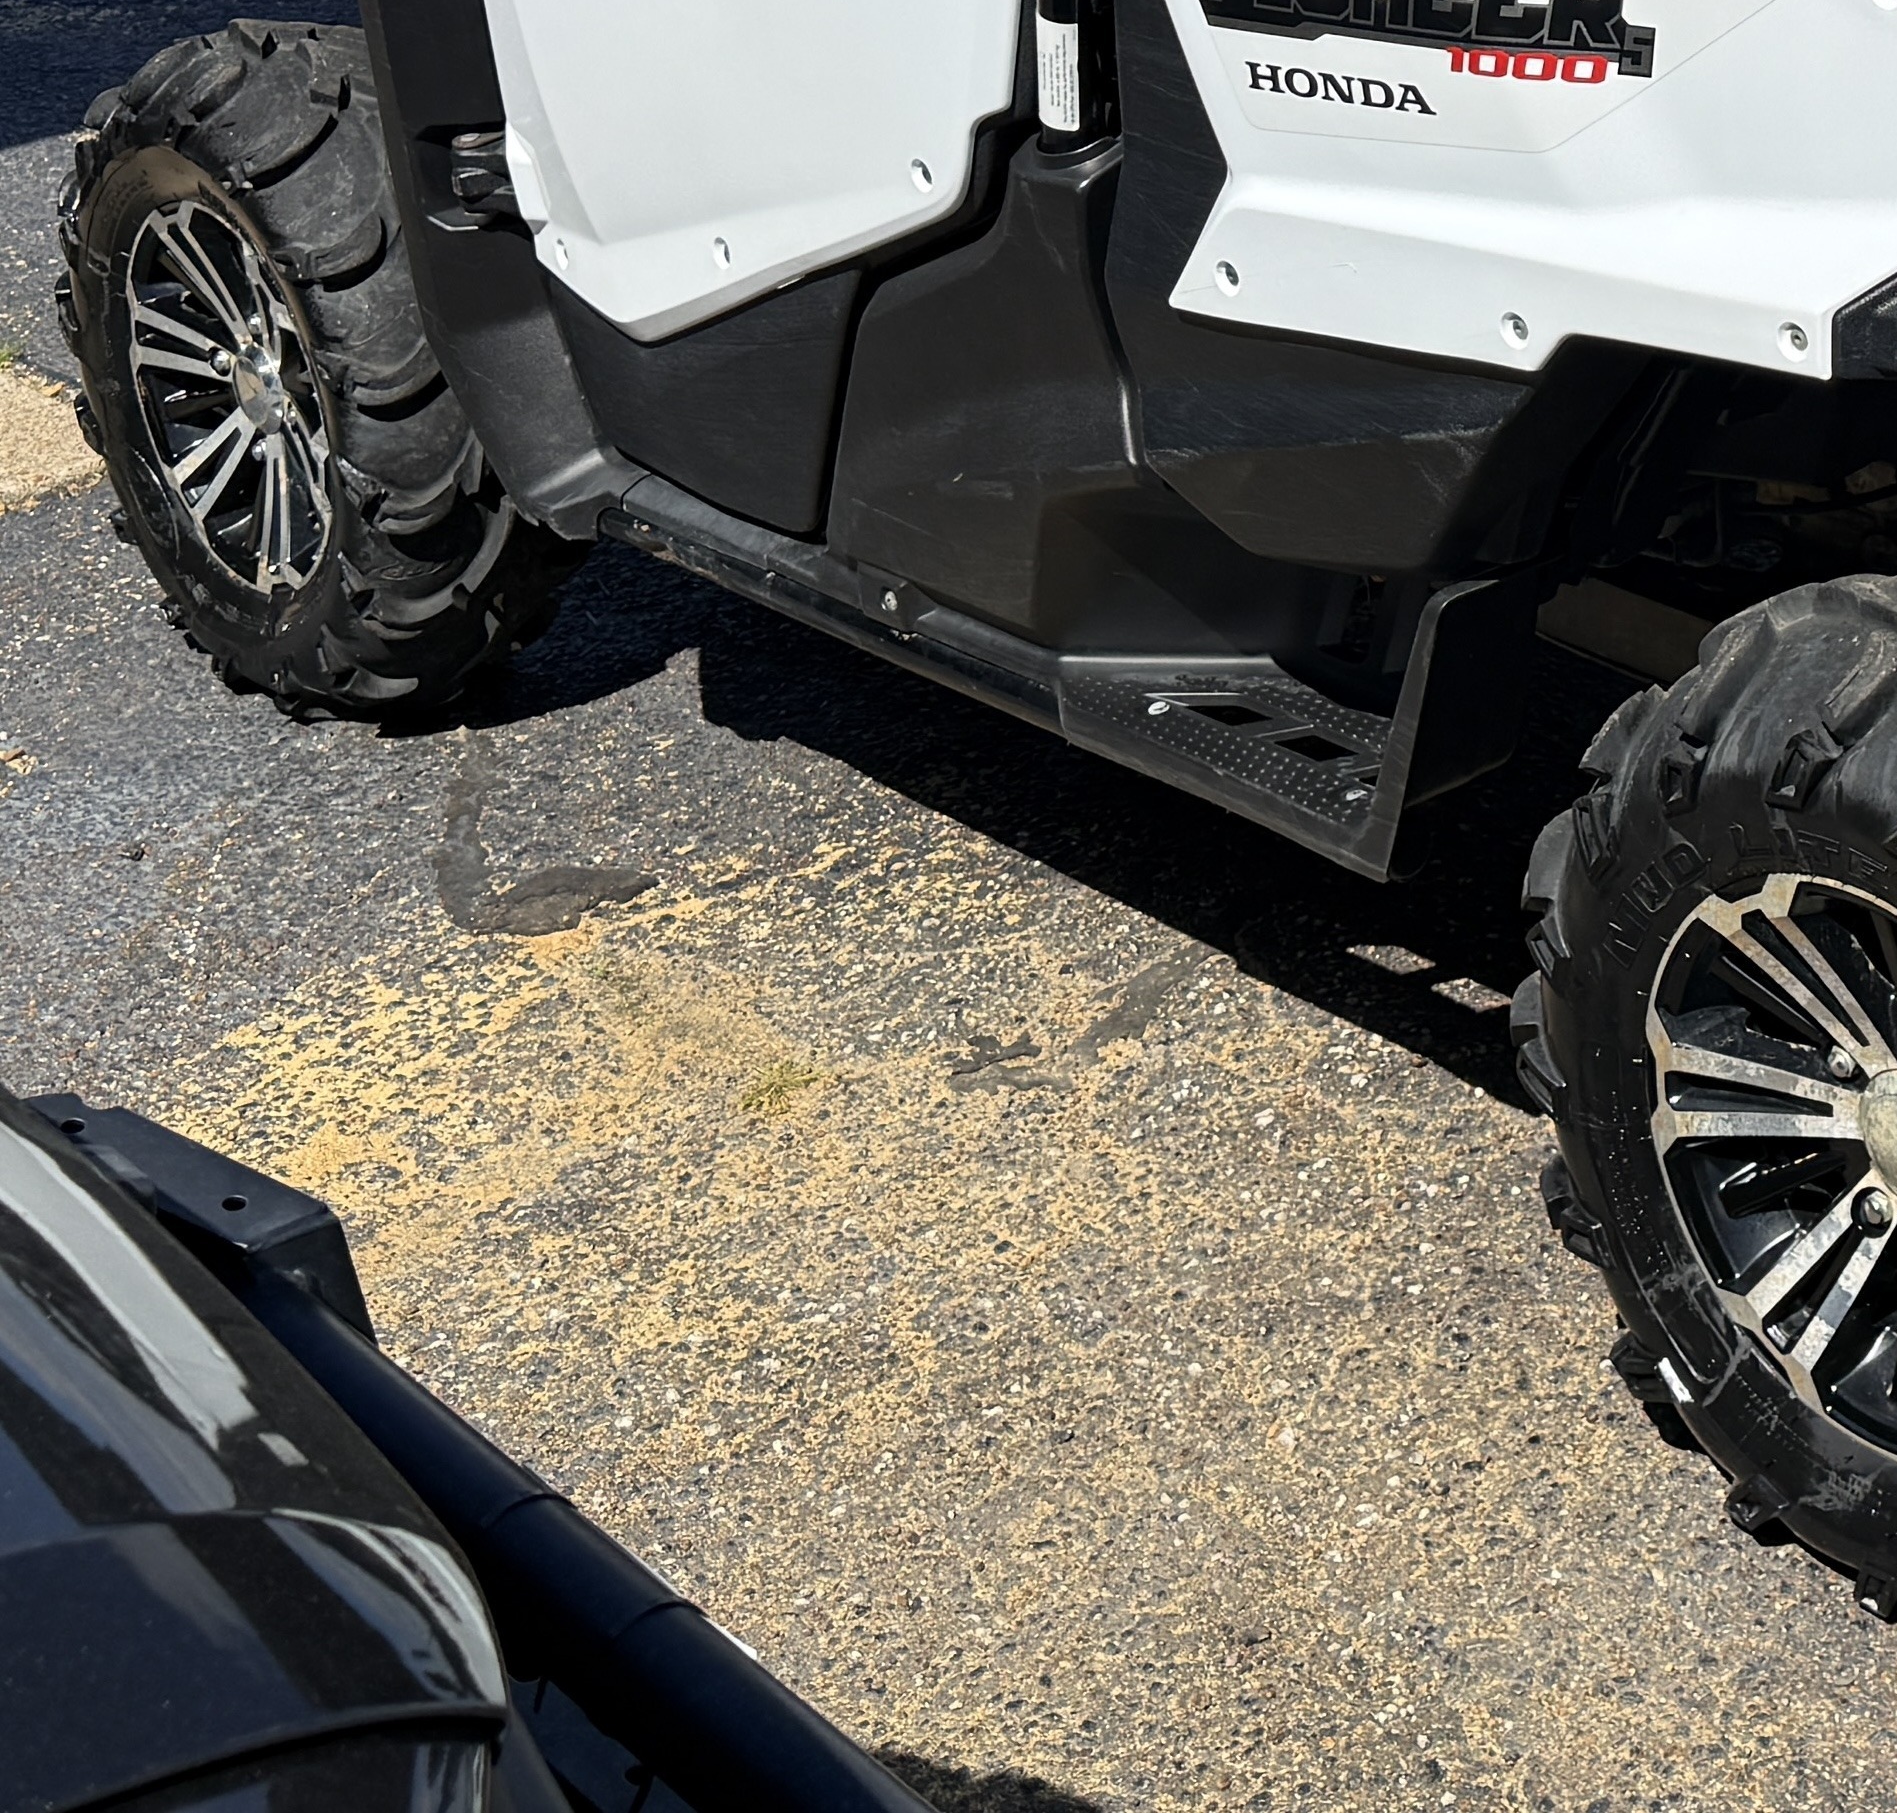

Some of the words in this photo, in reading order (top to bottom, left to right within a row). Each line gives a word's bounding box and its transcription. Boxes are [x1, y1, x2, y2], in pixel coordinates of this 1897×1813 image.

[1245, 61, 1437, 116] HONDA
[1446, 46, 1608, 84] 1000
[1602, 840, 1704, 970] MUD
[1729, 821, 1888, 886] LITE
